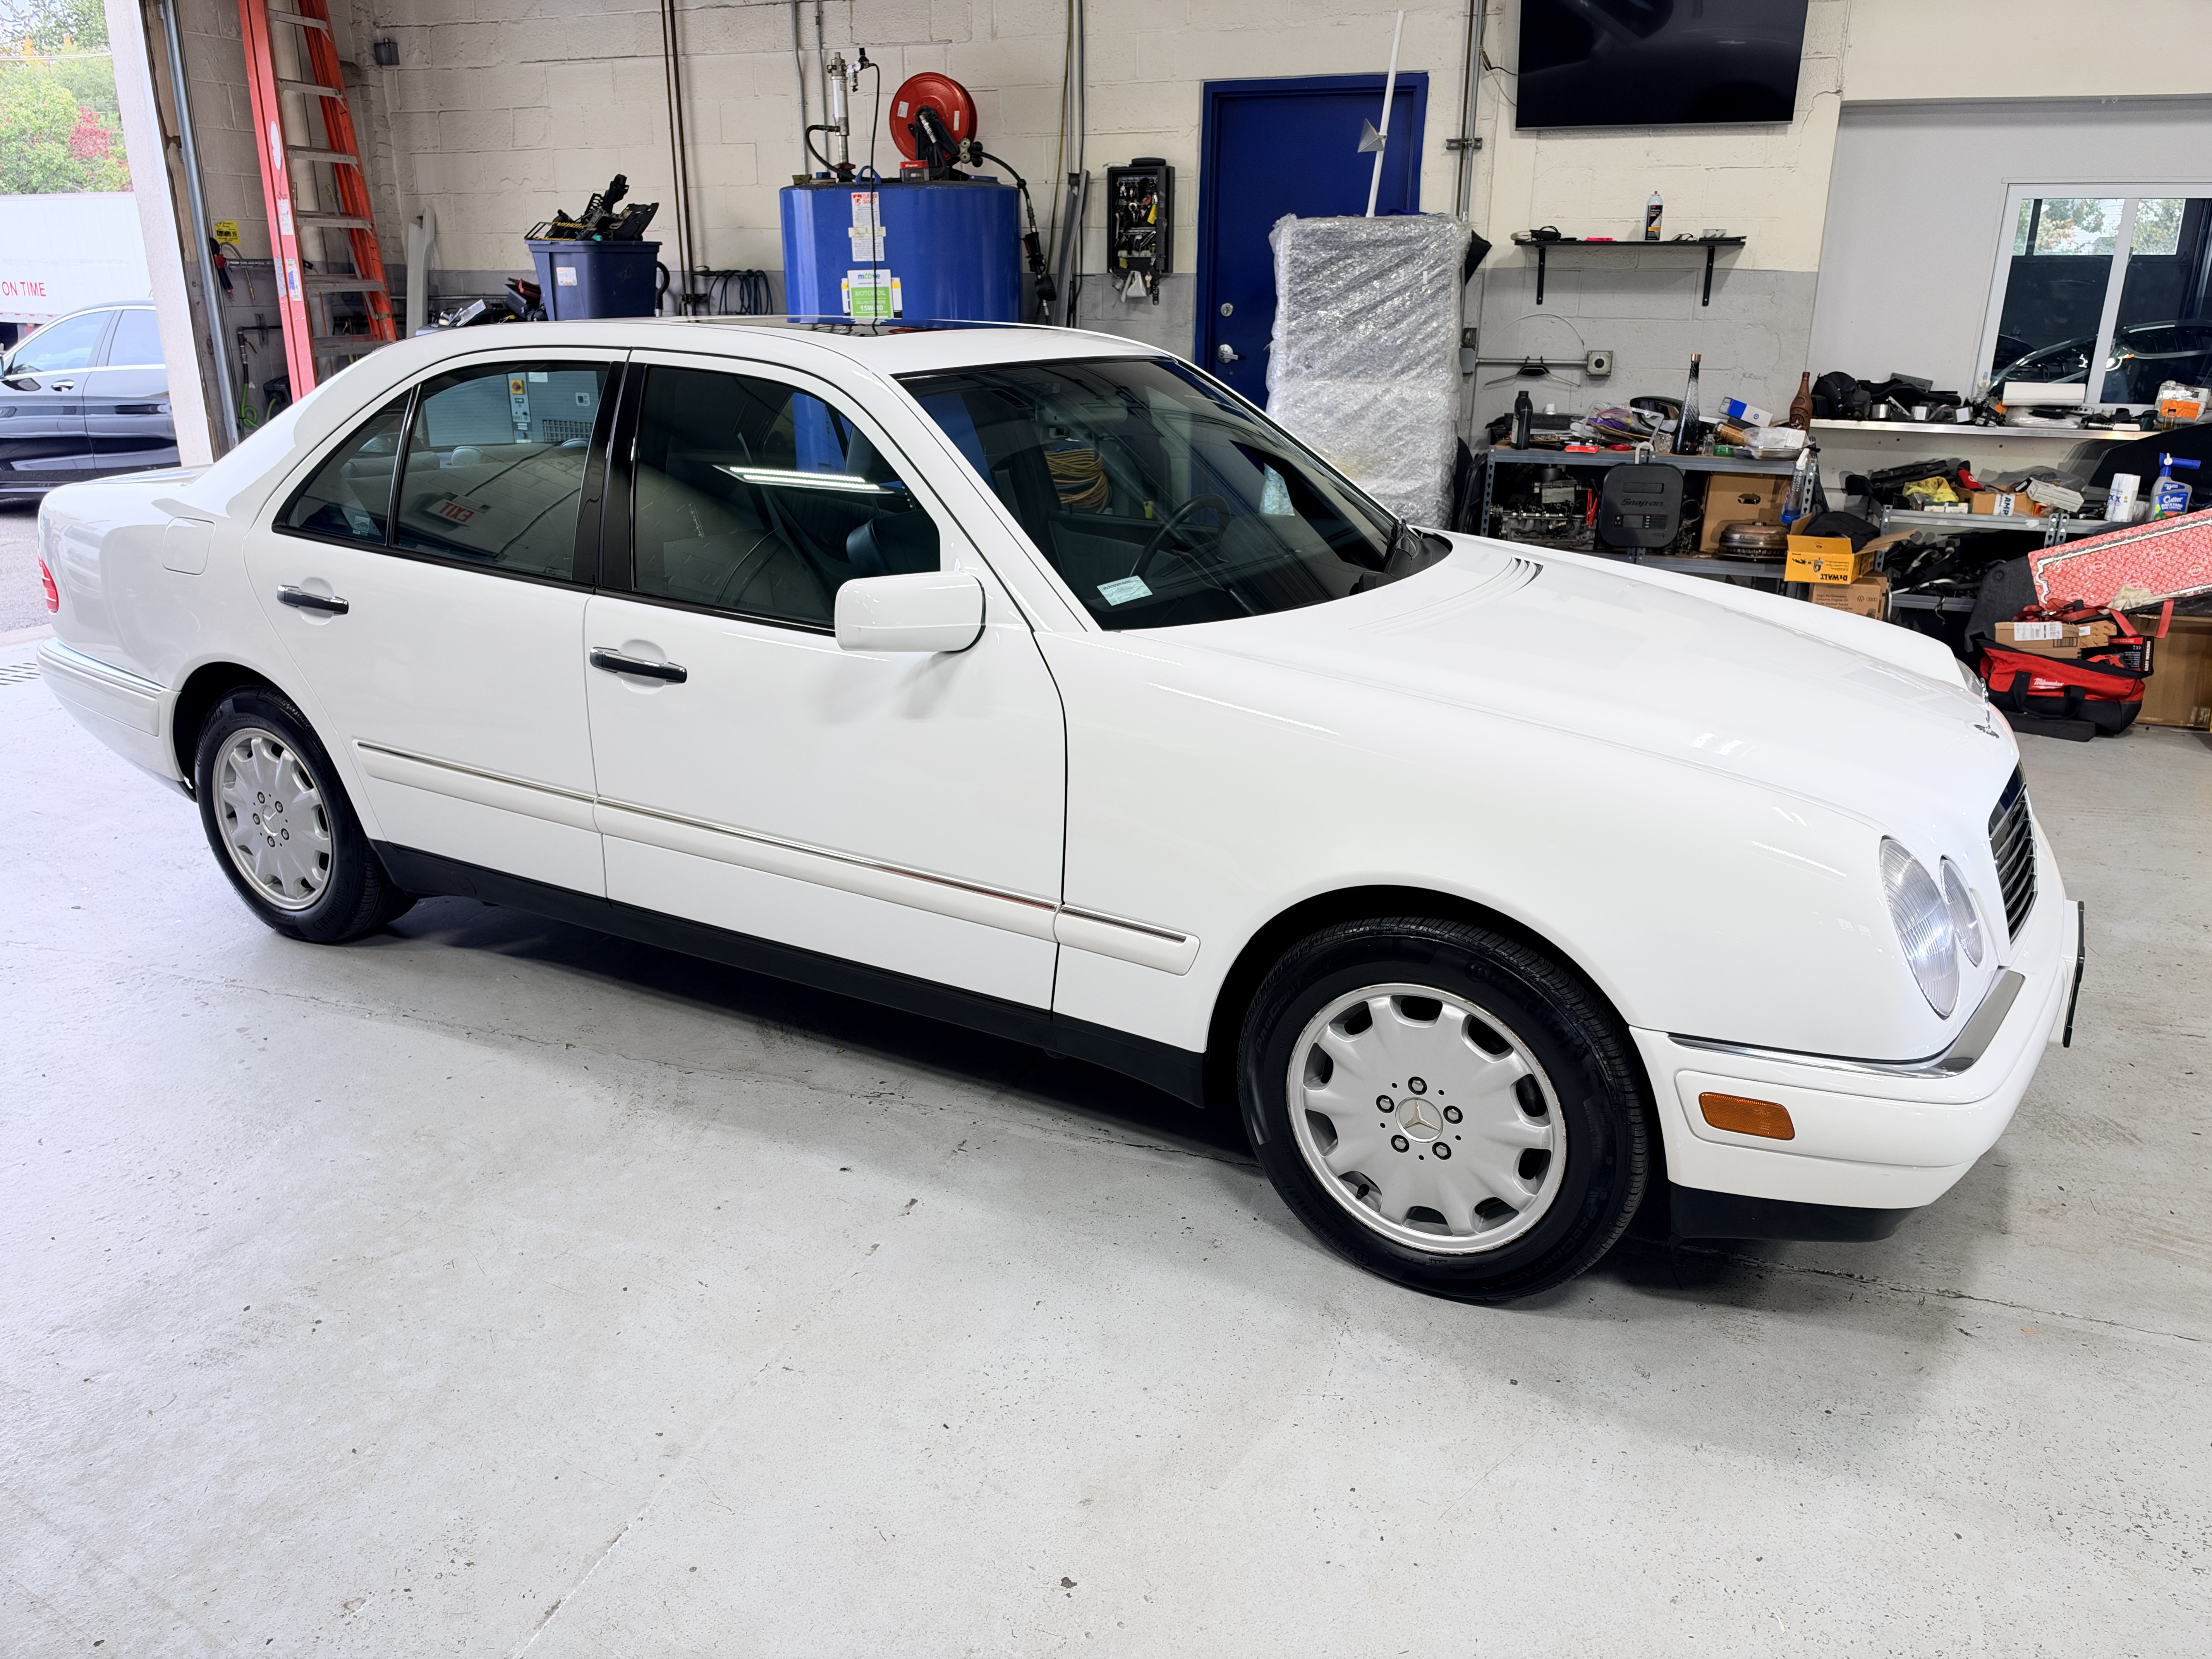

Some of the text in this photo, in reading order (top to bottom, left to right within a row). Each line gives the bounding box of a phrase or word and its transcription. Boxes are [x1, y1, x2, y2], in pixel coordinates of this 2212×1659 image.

[2, 282, 46, 297] ON TIME
[1621, 499, 1664, 507] Snap-on
[2163, 495, 2183, 503] Cutter
[2003, 496, 2011, 515] AMP
